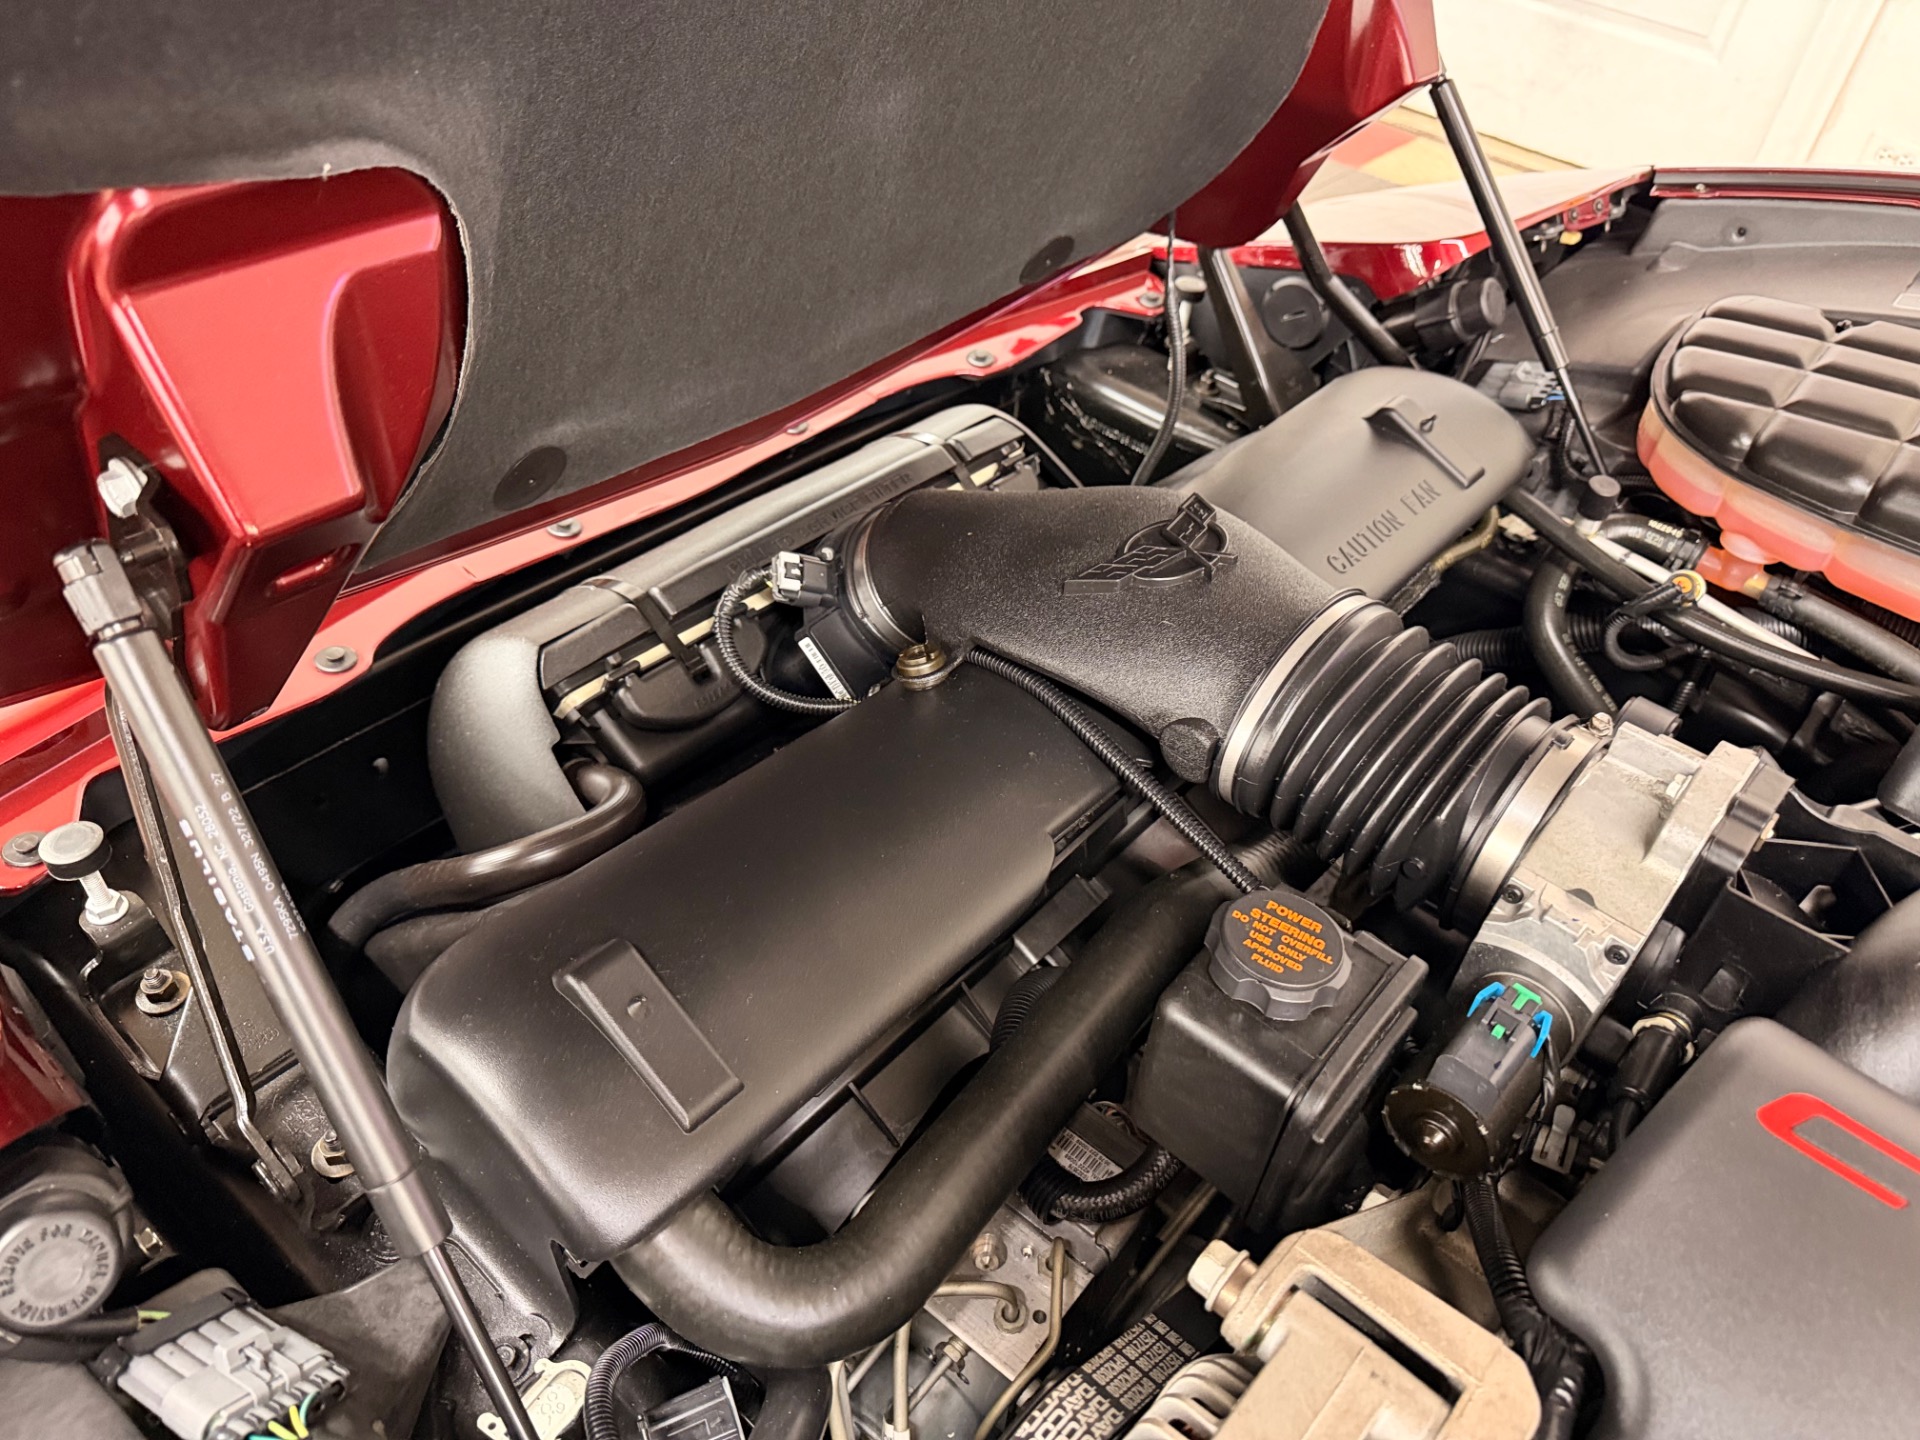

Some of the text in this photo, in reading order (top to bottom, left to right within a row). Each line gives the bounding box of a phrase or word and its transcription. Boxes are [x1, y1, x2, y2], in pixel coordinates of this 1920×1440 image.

[1327, 479, 1441, 574] CAUTION FAN
[210, 769, 224, 786] 27
[194, 801, 218, 839] 28052
[227, 805, 255, 847] 327/22
[213, 840, 229, 860] NC
[179, 819, 255, 962] STABILUS
[270, 894, 300, 940] 7295KA
[1250, 908, 1326, 950] STEERING
[1266, 900, 1322, 933] POWER
[1232, 910, 1334, 965] DO NOT OVERFILL
[1249, 930, 1307, 962] USE ONLY
[1243, 939, 1303, 972] APPROVED
[1251, 953, 1284, 973] FLUID
[1092, 1354, 1129, 1386] 6PK2030
[1106, 1366, 1142, 1398] 6PK2030
[1120, 1377, 1155, 1410] 6PK2030
